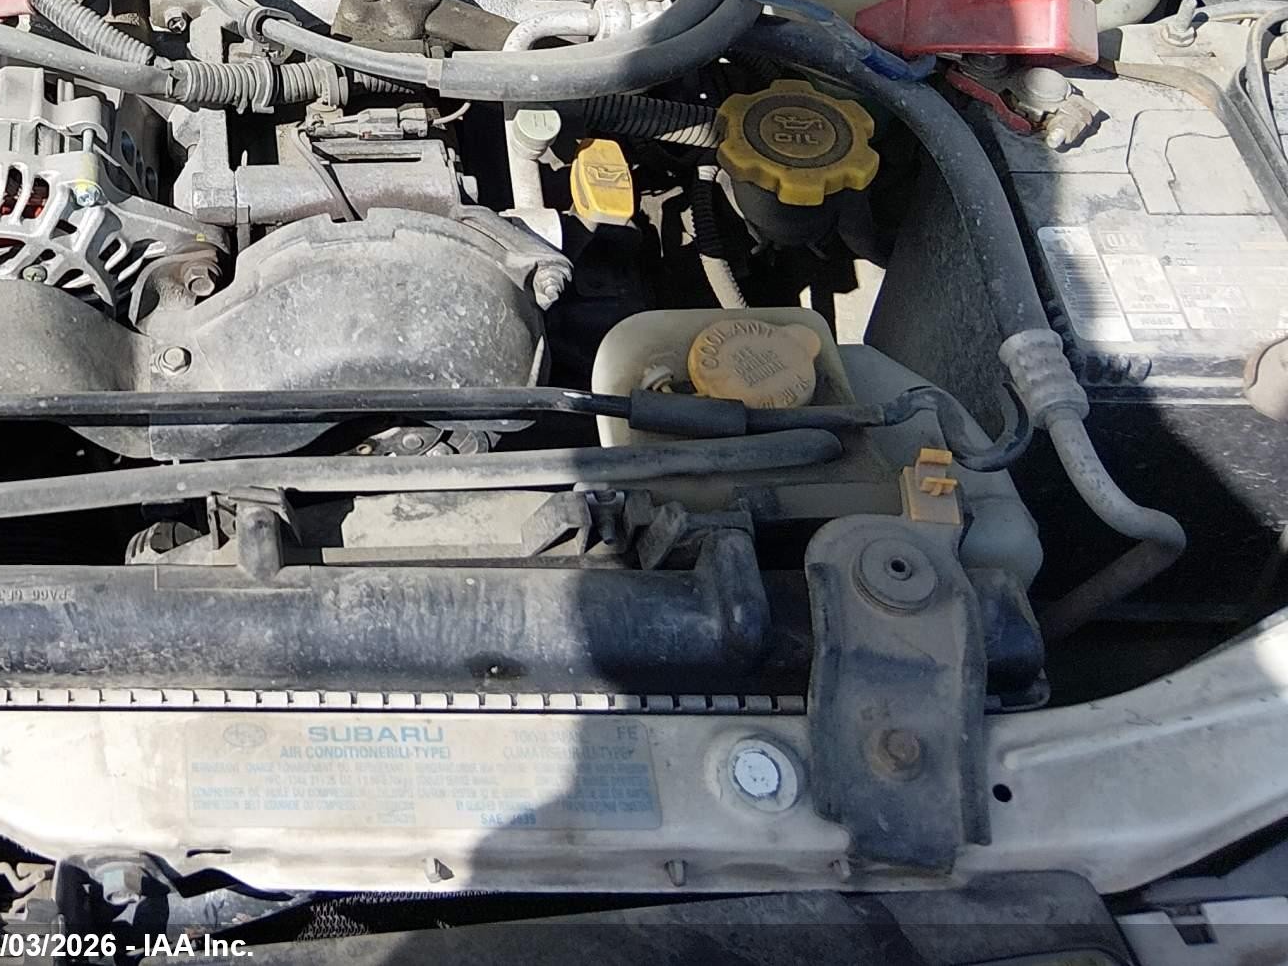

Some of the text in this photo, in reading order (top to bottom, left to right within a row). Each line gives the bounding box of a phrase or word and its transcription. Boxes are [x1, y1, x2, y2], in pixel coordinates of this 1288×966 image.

[774, 132, 820, 145] OIL
[698, 321, 776, 370] COOLANT
[308, 725, 444, 744] SUBARU
[616, 726, 640, 741] FE
[279, 745, 303, 760] AIR
